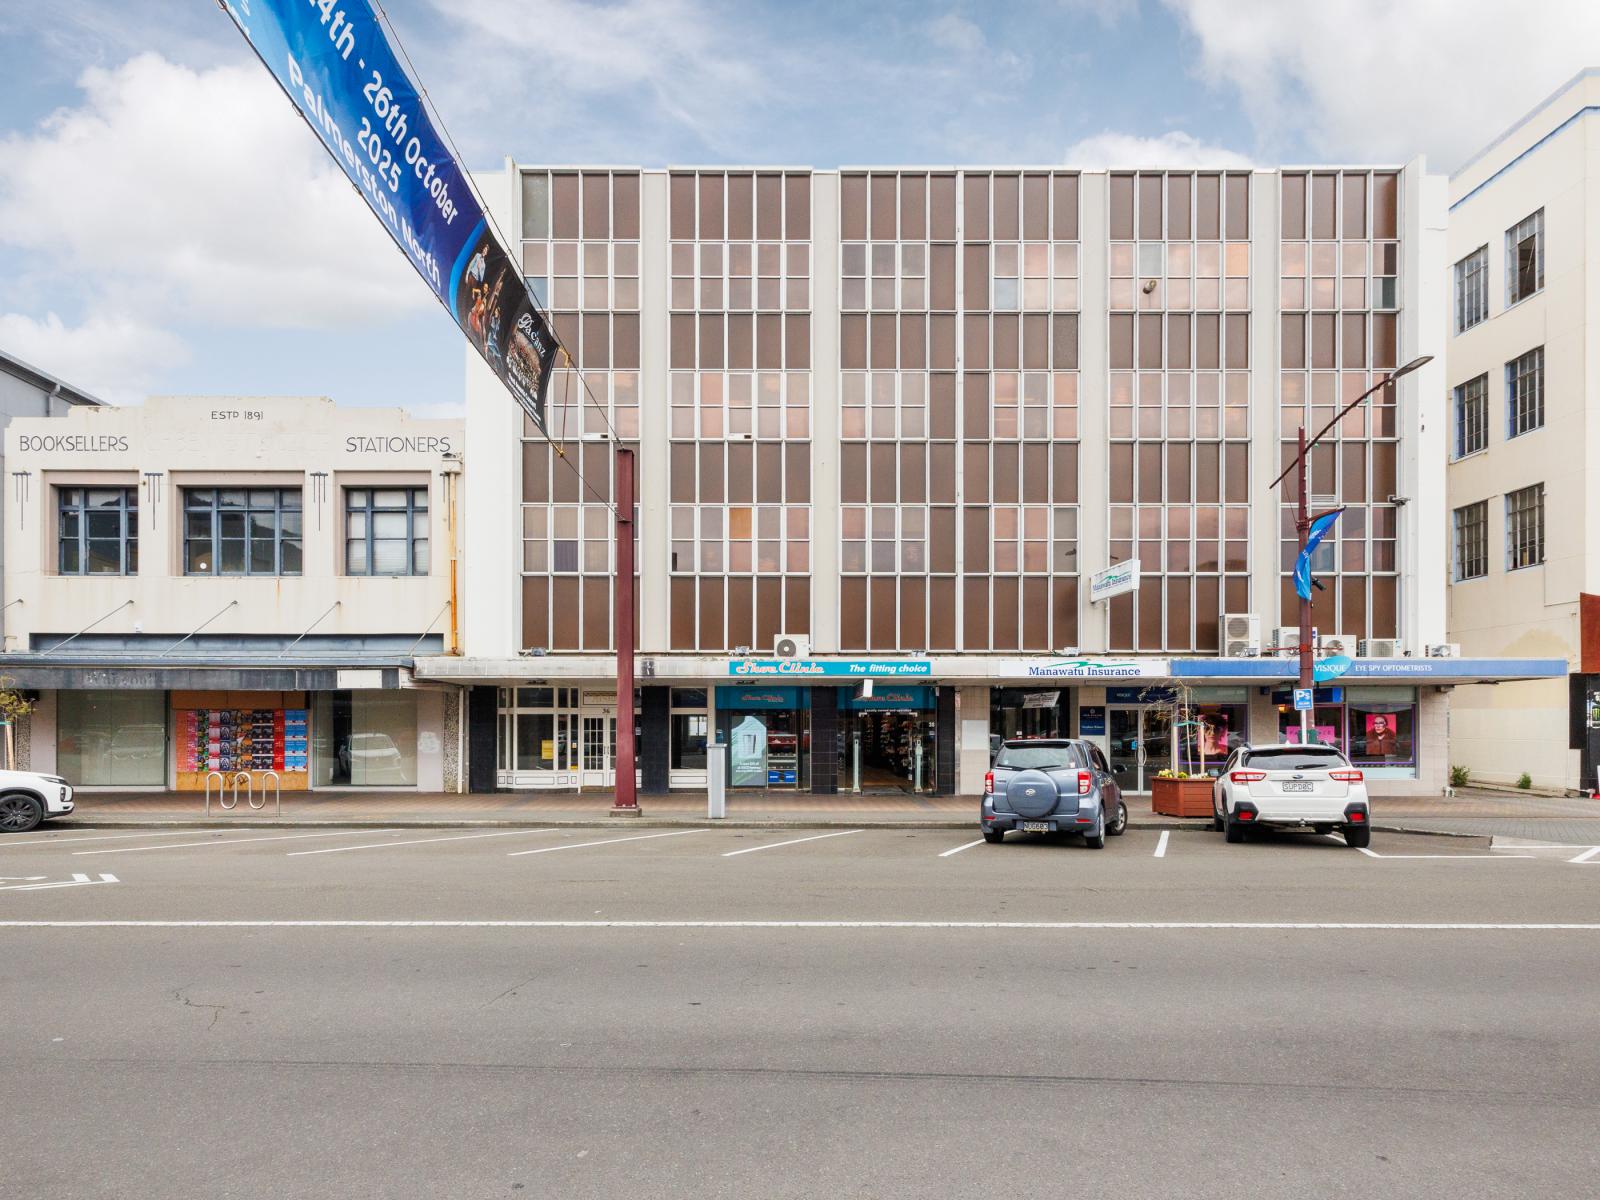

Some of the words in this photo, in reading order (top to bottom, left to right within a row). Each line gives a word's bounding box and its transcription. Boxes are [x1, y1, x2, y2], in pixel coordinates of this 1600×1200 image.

[363, 70, 408, 145] 26th
[405, 136, 458, 225] October
[357, 116, 401, 193] 2025
[287, 51, 399, 230] Palmerston
[400, 216, 441, 288] North
[244, 410, 264, 421] 1891
[19, 435, 129, 452] BOOKSELLERS
[345, 436, 451, 453] STATIONERS
[736, 661, 778, 673] Shoe
[779, 660, 825, 673] Clinic
[849, 664, 866, 673] The
[869, 664, 897, 674] fitting
[898, 664, 928, 673] choice
[1029, 667, 1084, 676] Manawatu
[1088, 667, 1140, 676] Insurance
[1314, 664, 1347, 673] VISIQUE
[1355, 664, 1368, 672] EYE
[1369, 664, 1381, 672] SPY
[1382, 664, 1433, 672] OPTOMETRISTS
